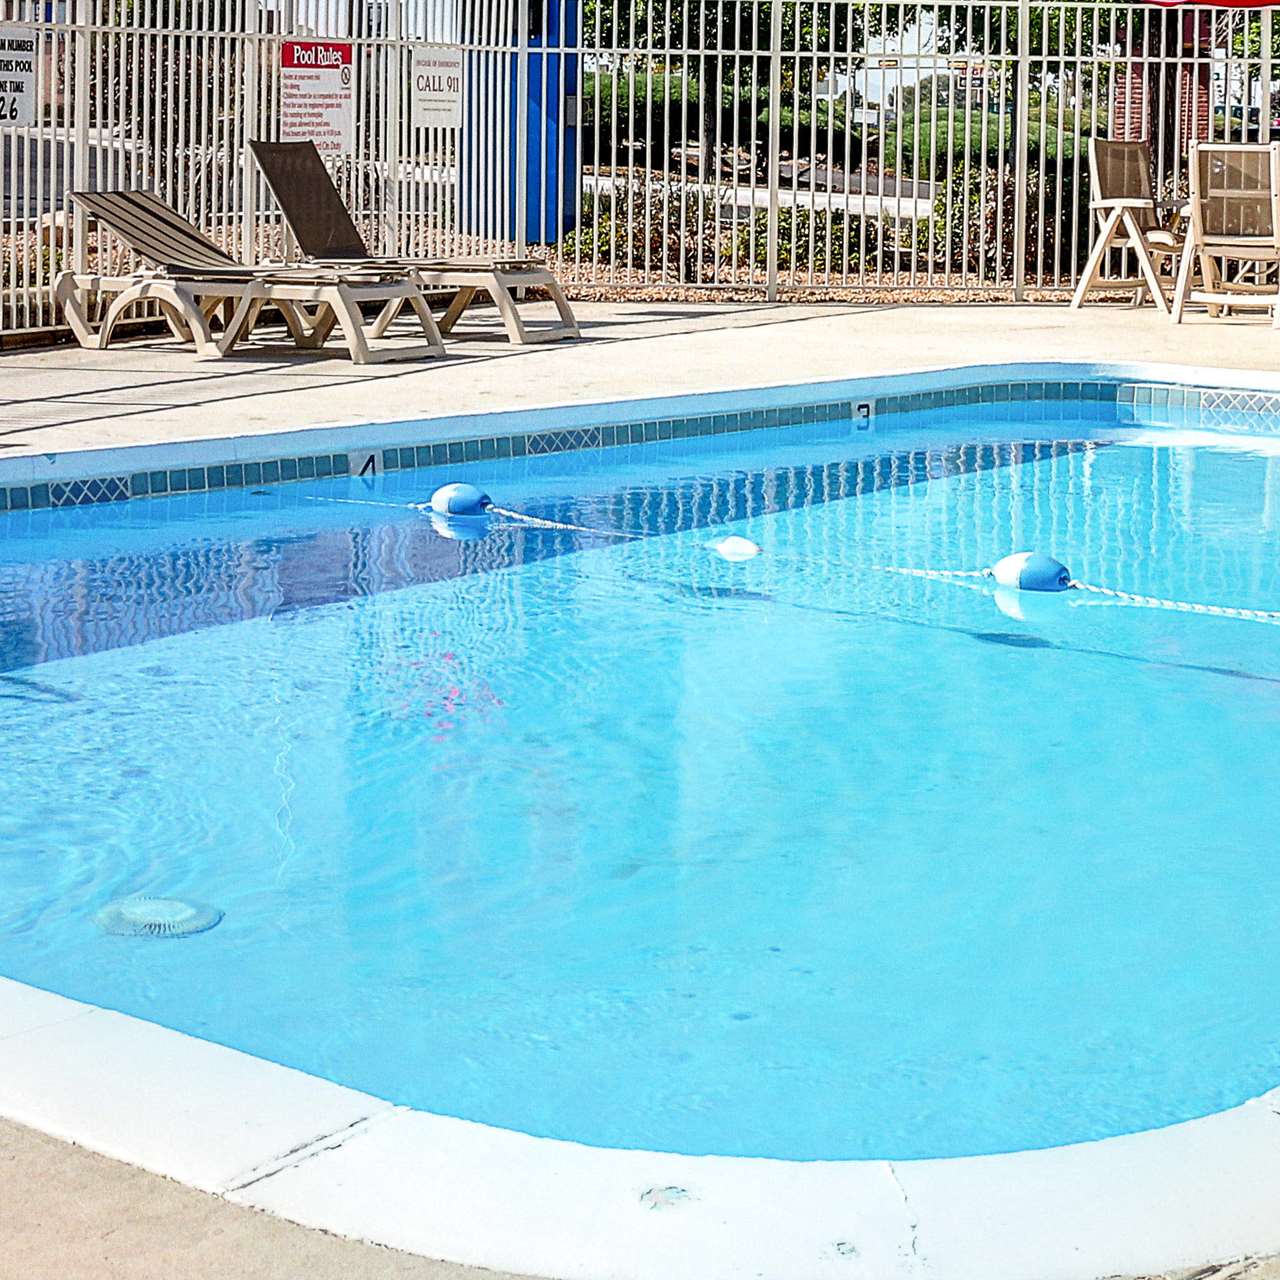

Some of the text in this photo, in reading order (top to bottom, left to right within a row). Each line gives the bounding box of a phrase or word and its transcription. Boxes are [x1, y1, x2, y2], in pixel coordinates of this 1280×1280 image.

[7, 39, 34, 52] NUMBER
[293, 45, 342, 65] Pool Rules
[0, 59, 14, 72] THIS
[15, 60, 33, 73] POOL
[9, 80, 24, 93] TIME
[416, 74, 459, 93] CALL 911
